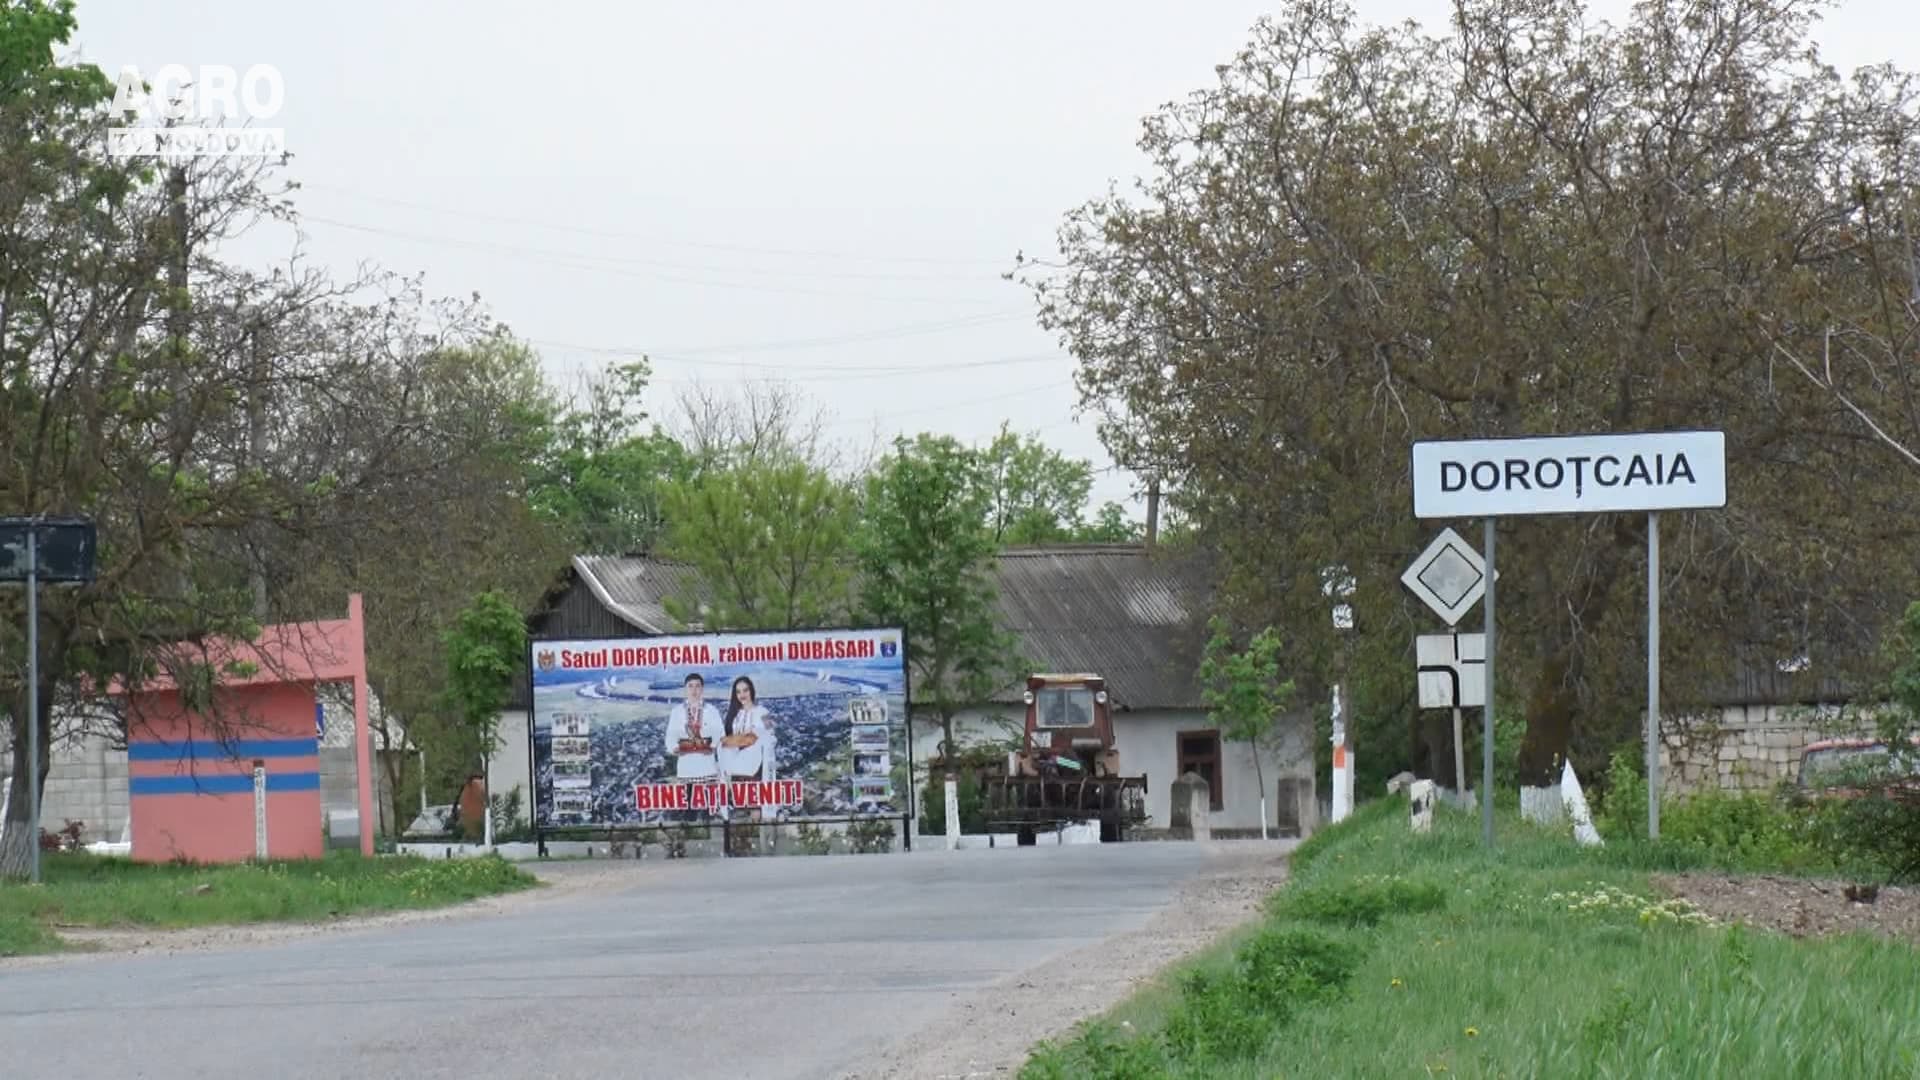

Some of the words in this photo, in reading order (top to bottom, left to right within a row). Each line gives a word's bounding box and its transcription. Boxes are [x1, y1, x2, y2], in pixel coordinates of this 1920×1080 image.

[1440, 453, 1696, 498] DOROȚCAIA
[561, 648, 607, 669] Satul
[612, 645, 715, 670] DOROȚCAIA,
[719, 642, 784, 663] raionul
[636, 784, 688, 810] BINE
[731, 780, 802, 808] VENIT!
